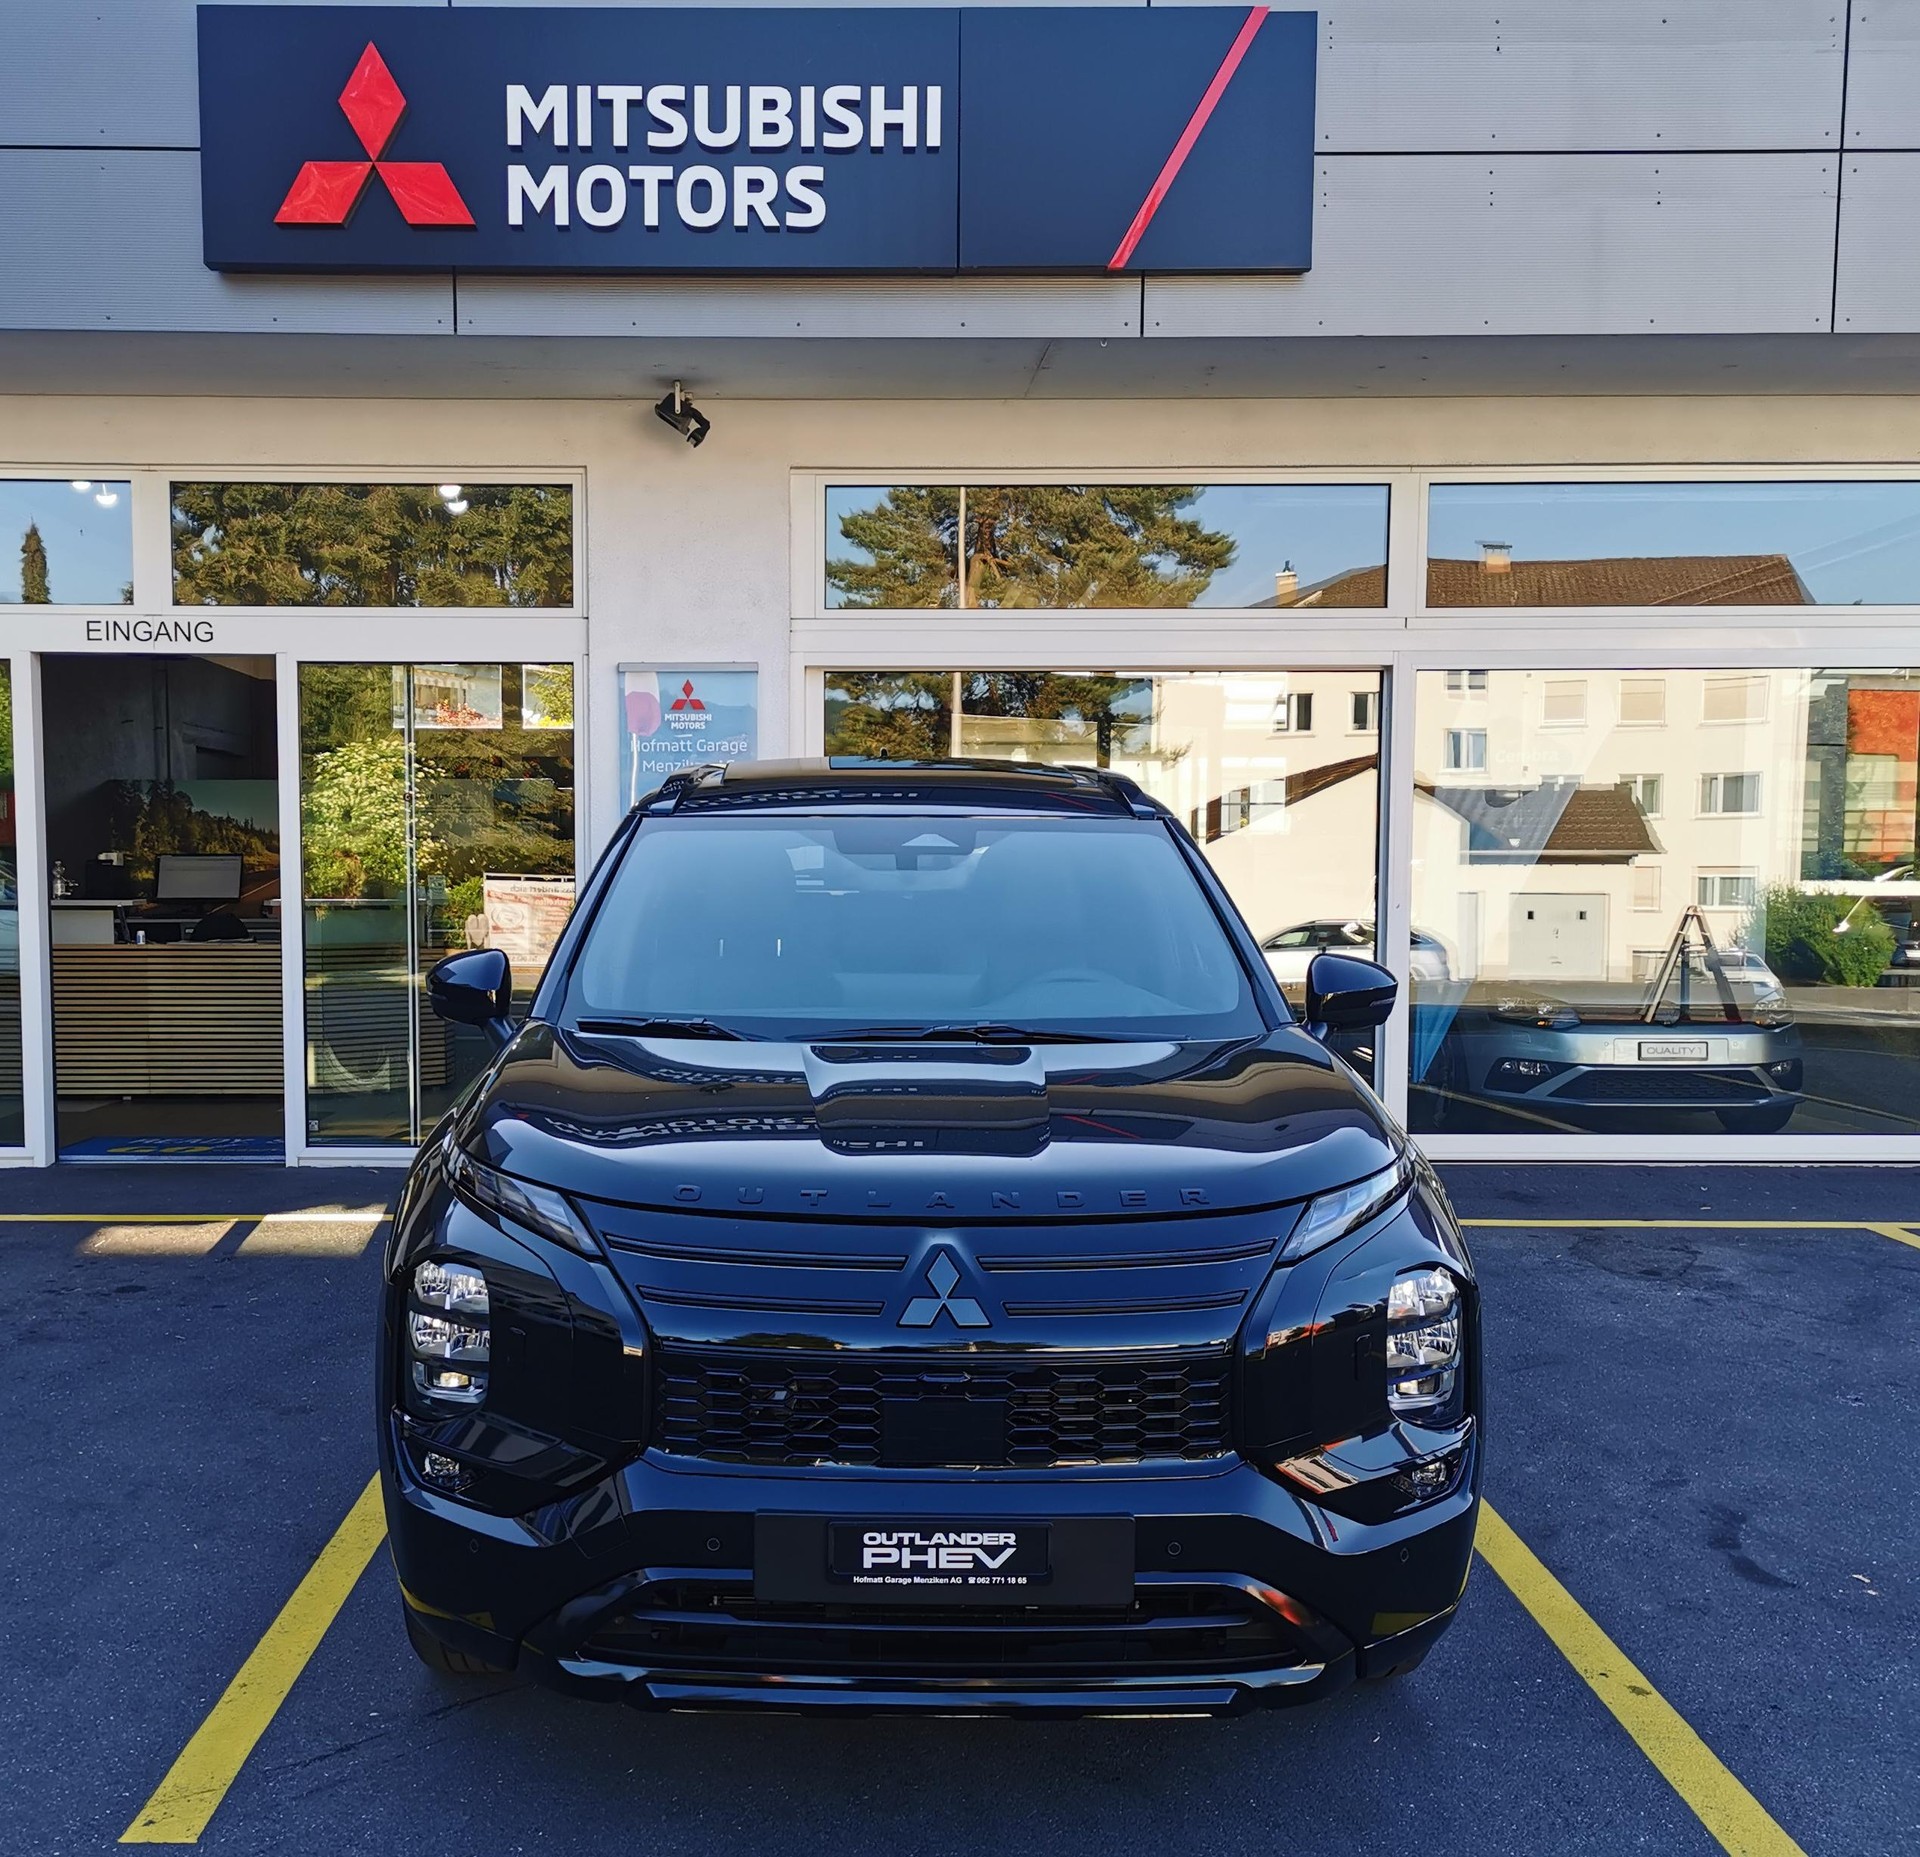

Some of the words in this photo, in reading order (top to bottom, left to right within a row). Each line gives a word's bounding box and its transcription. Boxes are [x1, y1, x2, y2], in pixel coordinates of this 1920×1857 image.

[506, 84, 942, 150] MITSUBISHI
[507, 164, 827, 230] MOTORS
[85, 620, 214, 643] EINGANG
[664, 713, 712, 721] MITSUBISHI
[671, 722, 706, 730] MOTORS
[630, 739, 693, 752] Hofmatt
[696, 739, 748, 754] Garage
[673, 1184, 1212, 1209] OUTLANDER
[863, 1532, 1017, 1546] OUTLANDER
[862, 1547, 1017, 1569] PHEV
[853, 1576, 883, 1584] Hofmatt
[884, 1576, 912, 1585] Garage
[913, 1576, 949, 1584] Menziken
